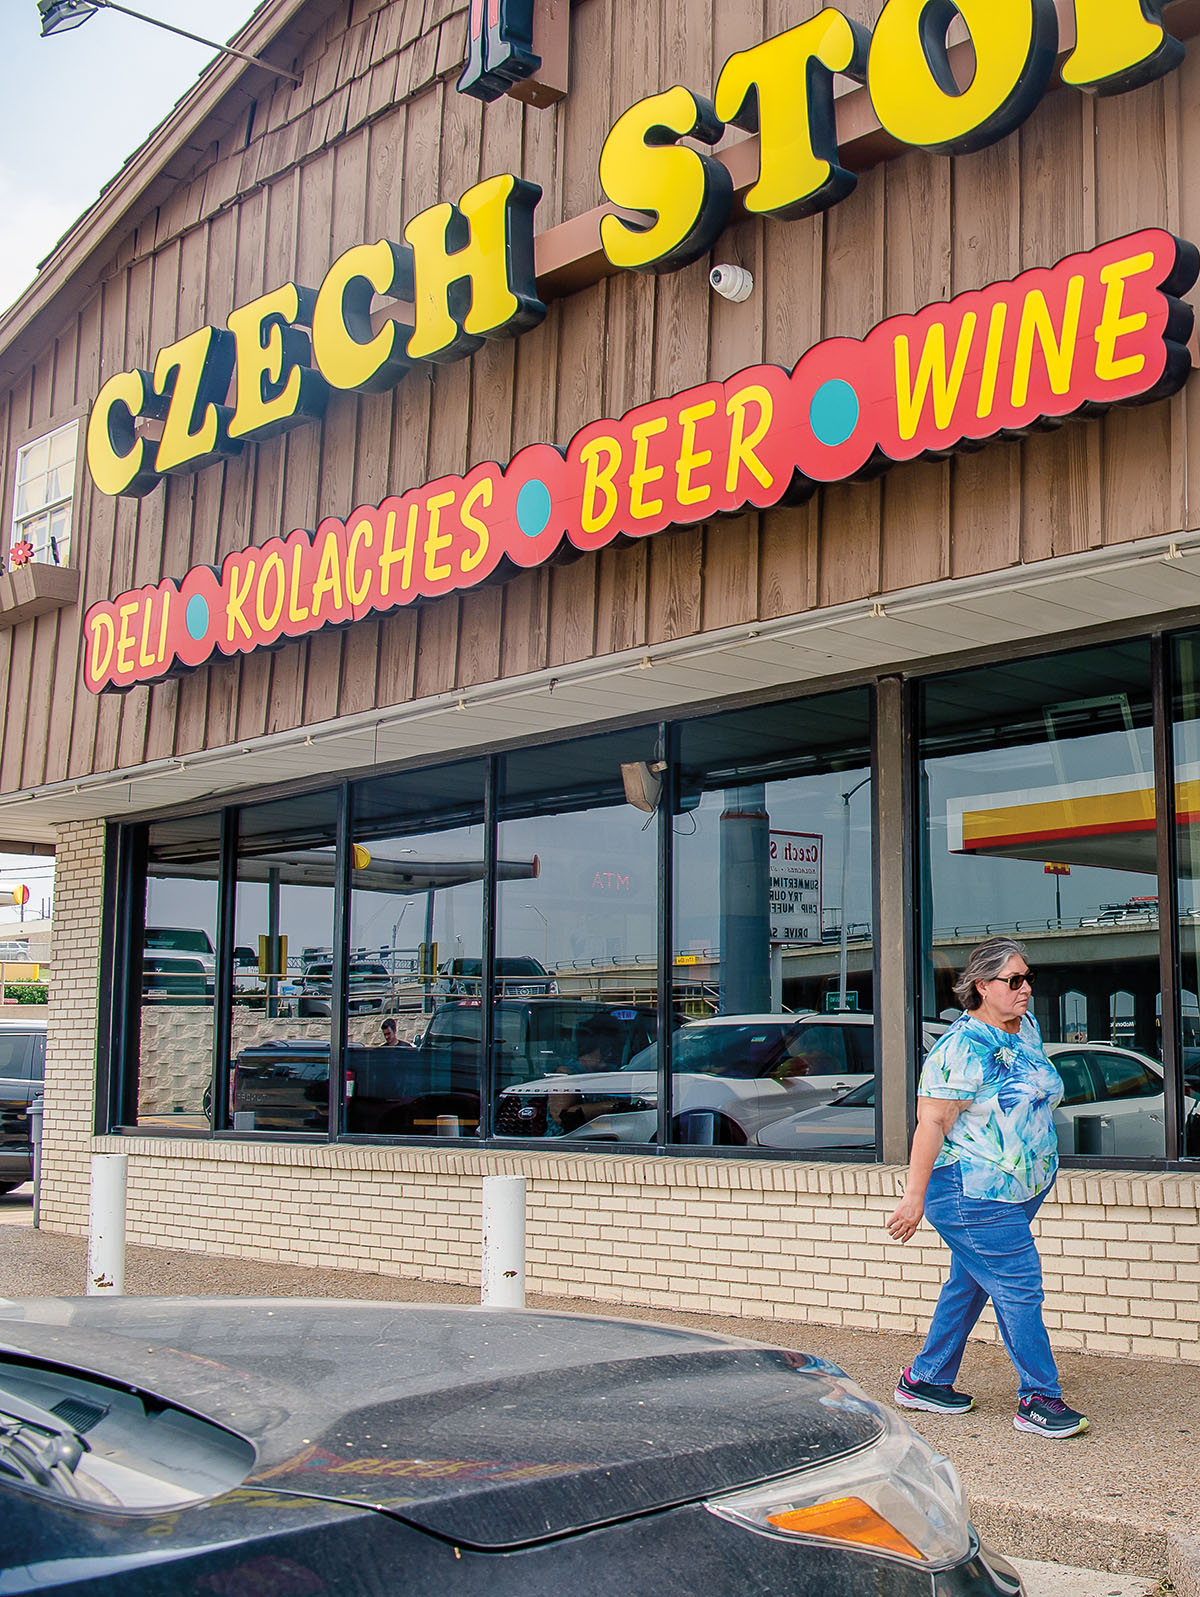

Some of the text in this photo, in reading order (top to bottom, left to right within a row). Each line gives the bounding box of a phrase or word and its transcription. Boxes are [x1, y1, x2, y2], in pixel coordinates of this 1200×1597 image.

[86, 173, 540, 498] CZECH
[89, 250, 1156, 684] DELI KOLACHES BEER WINE
[592, 872, 630, 891] ATM
[1029, 1410, 1048, 1425] HOKA
